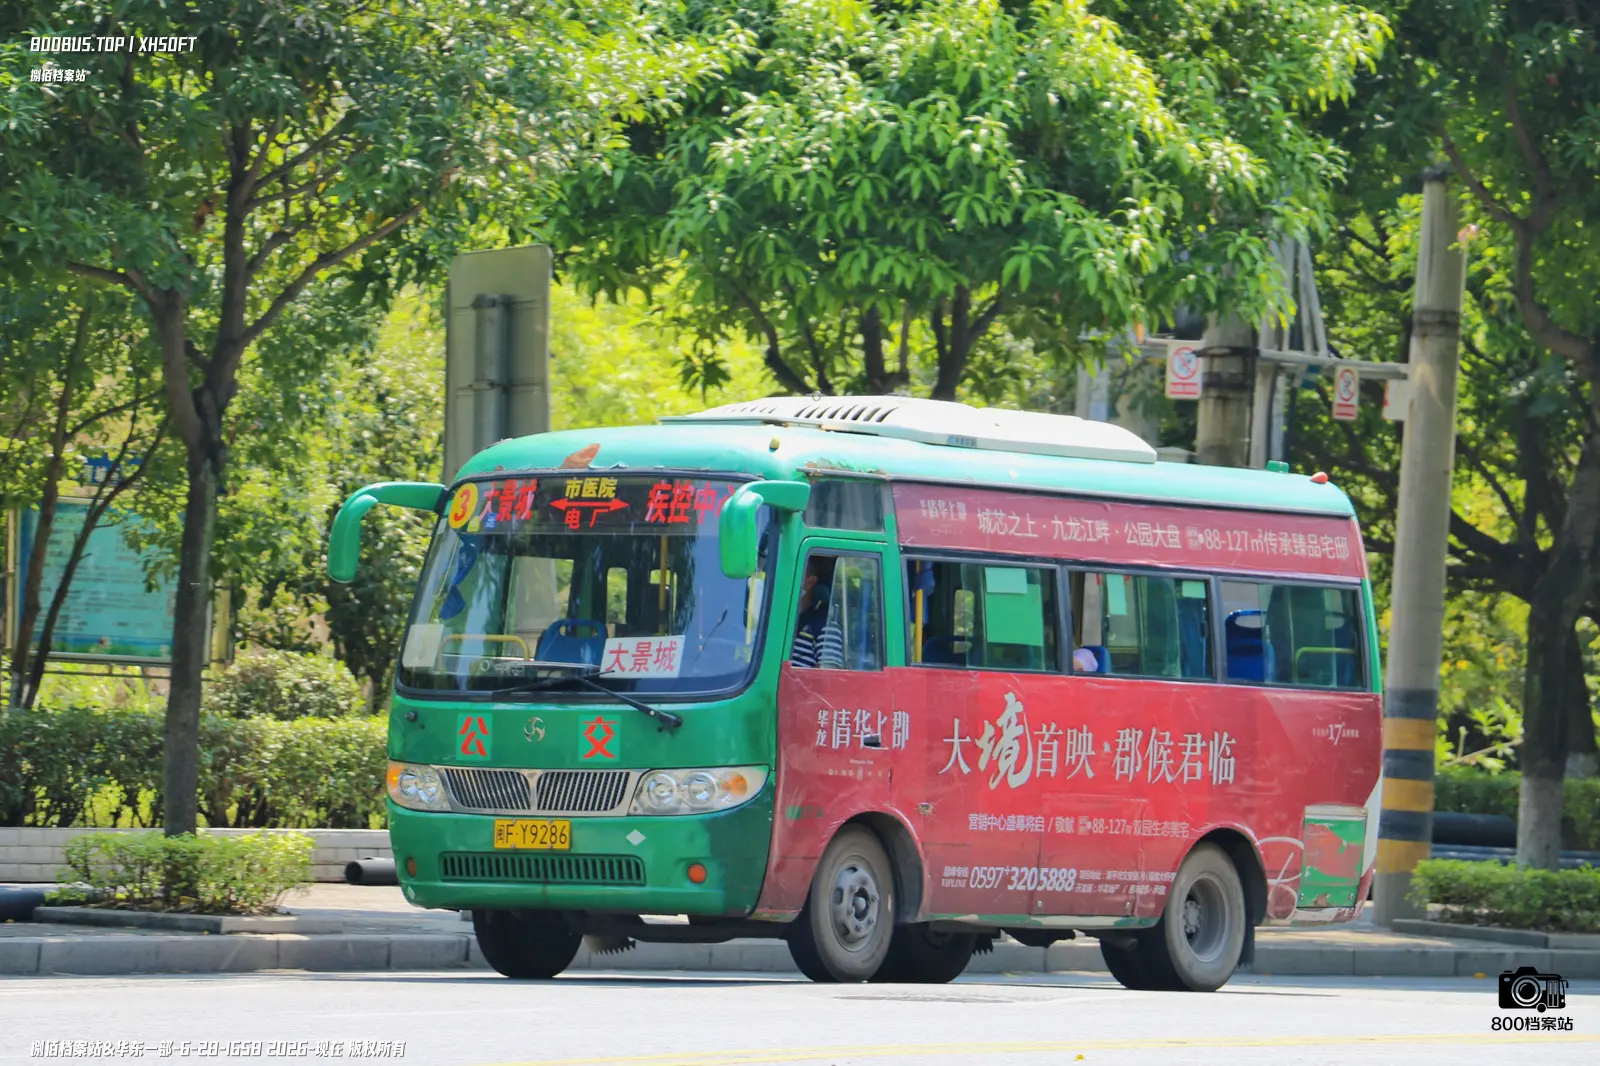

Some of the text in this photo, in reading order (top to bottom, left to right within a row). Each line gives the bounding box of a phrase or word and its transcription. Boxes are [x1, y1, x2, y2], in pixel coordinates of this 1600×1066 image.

[453, 488, 471, 522] 3
[479, 478, 538, 522] 大景城
[565, 477, 618, 499] 市医院
[605, 640, 677, 673] 大景城
[459, 716, 490, 757] 公
[582, 716, 616, 759] 交
